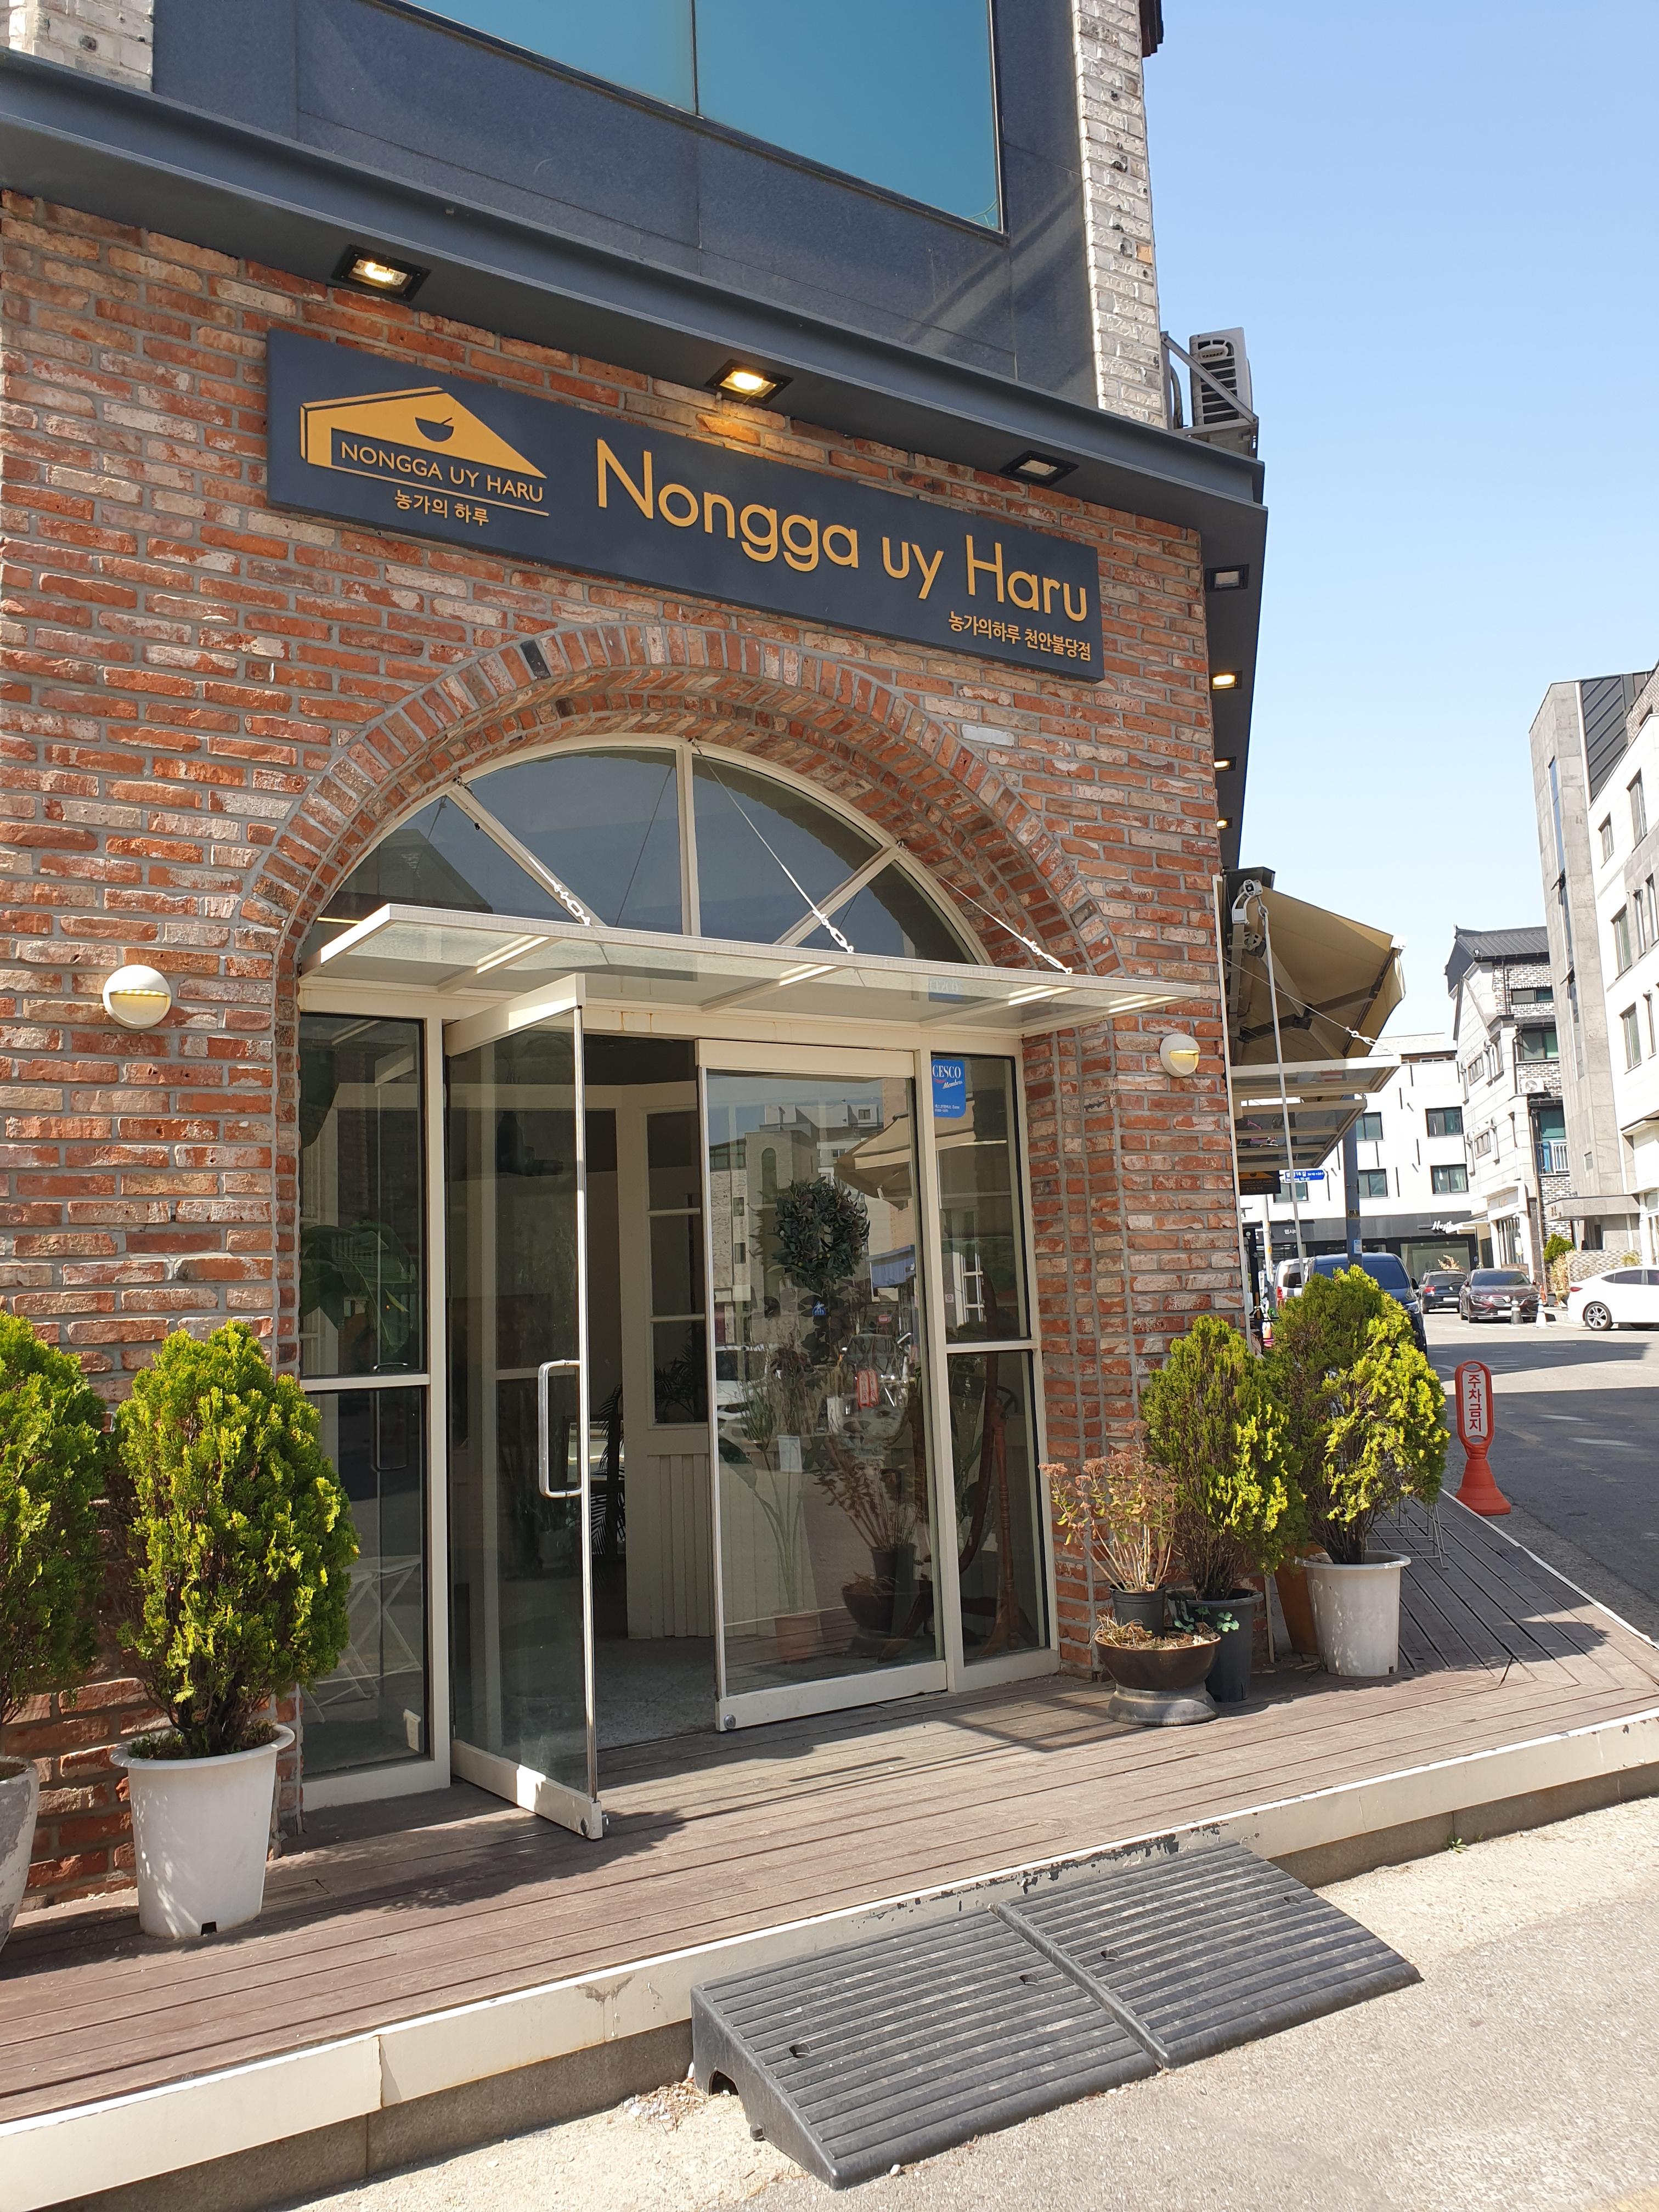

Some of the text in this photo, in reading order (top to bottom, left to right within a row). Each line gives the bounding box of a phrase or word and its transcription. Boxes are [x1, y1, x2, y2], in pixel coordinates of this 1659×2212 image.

[341, 441, 543, 503] NONGGA UY HARU
[394, 489, 489, 526] 농가의 하루
[596, 438, 1087, 622] Nongga uy Haru
[948, 611, 1091, 662] 농가의하루 천안불당점
[932, 1064, 961, 1079] CESCO
[1468, 1374, 1482, 1432] 주차금지
